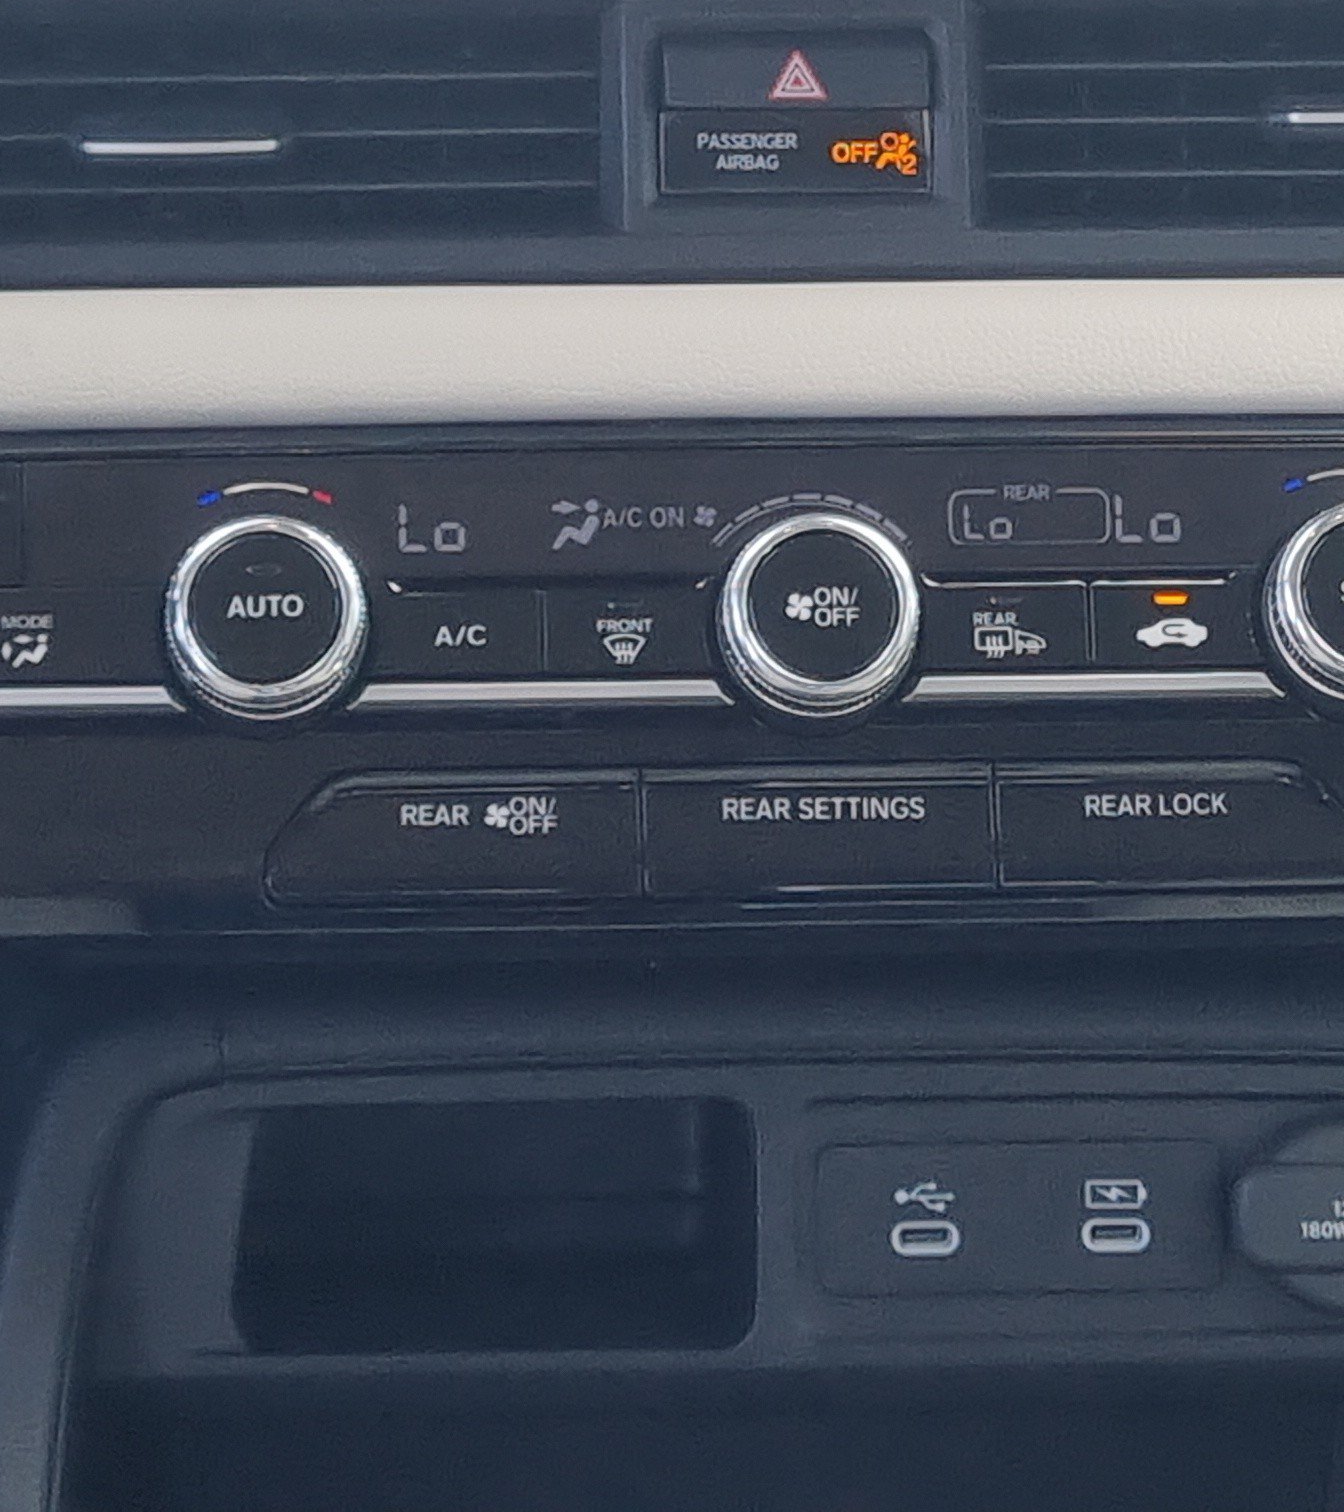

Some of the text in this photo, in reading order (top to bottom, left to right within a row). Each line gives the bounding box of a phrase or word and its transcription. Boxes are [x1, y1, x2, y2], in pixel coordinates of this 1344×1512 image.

[697, 133, 798, 149] PASSENGER
[716, 154, 779, 170] AIRBAG
[831, 142, 879, 164] OFF
[1004, 485, 1050, 500] REAR
[398, 503, 466, 552] Lo
[602, 509, 684, 527] A/C ON
[963, 505, 1013, 539] Lo
[1113, 494, 1182, 543] Lo
[814, 586, 858, 605] ON/
[227, 594, 304, 618] AUTO
[1, 614, 53, 629] MODE
[596, 618, 653, 633] FRONT
[814, 607, 860, 627] OFF
[973, 612, 1016, 626] REAR
[434, 626, 487, 646] A/C
[400, 796, 556, 826] REAR ON/
[722, 797, 926, 821] REAR SETTINGS
[1084, 793, 1228, 817] REAR LOCK
[509, 815, 558, 836] OFF
